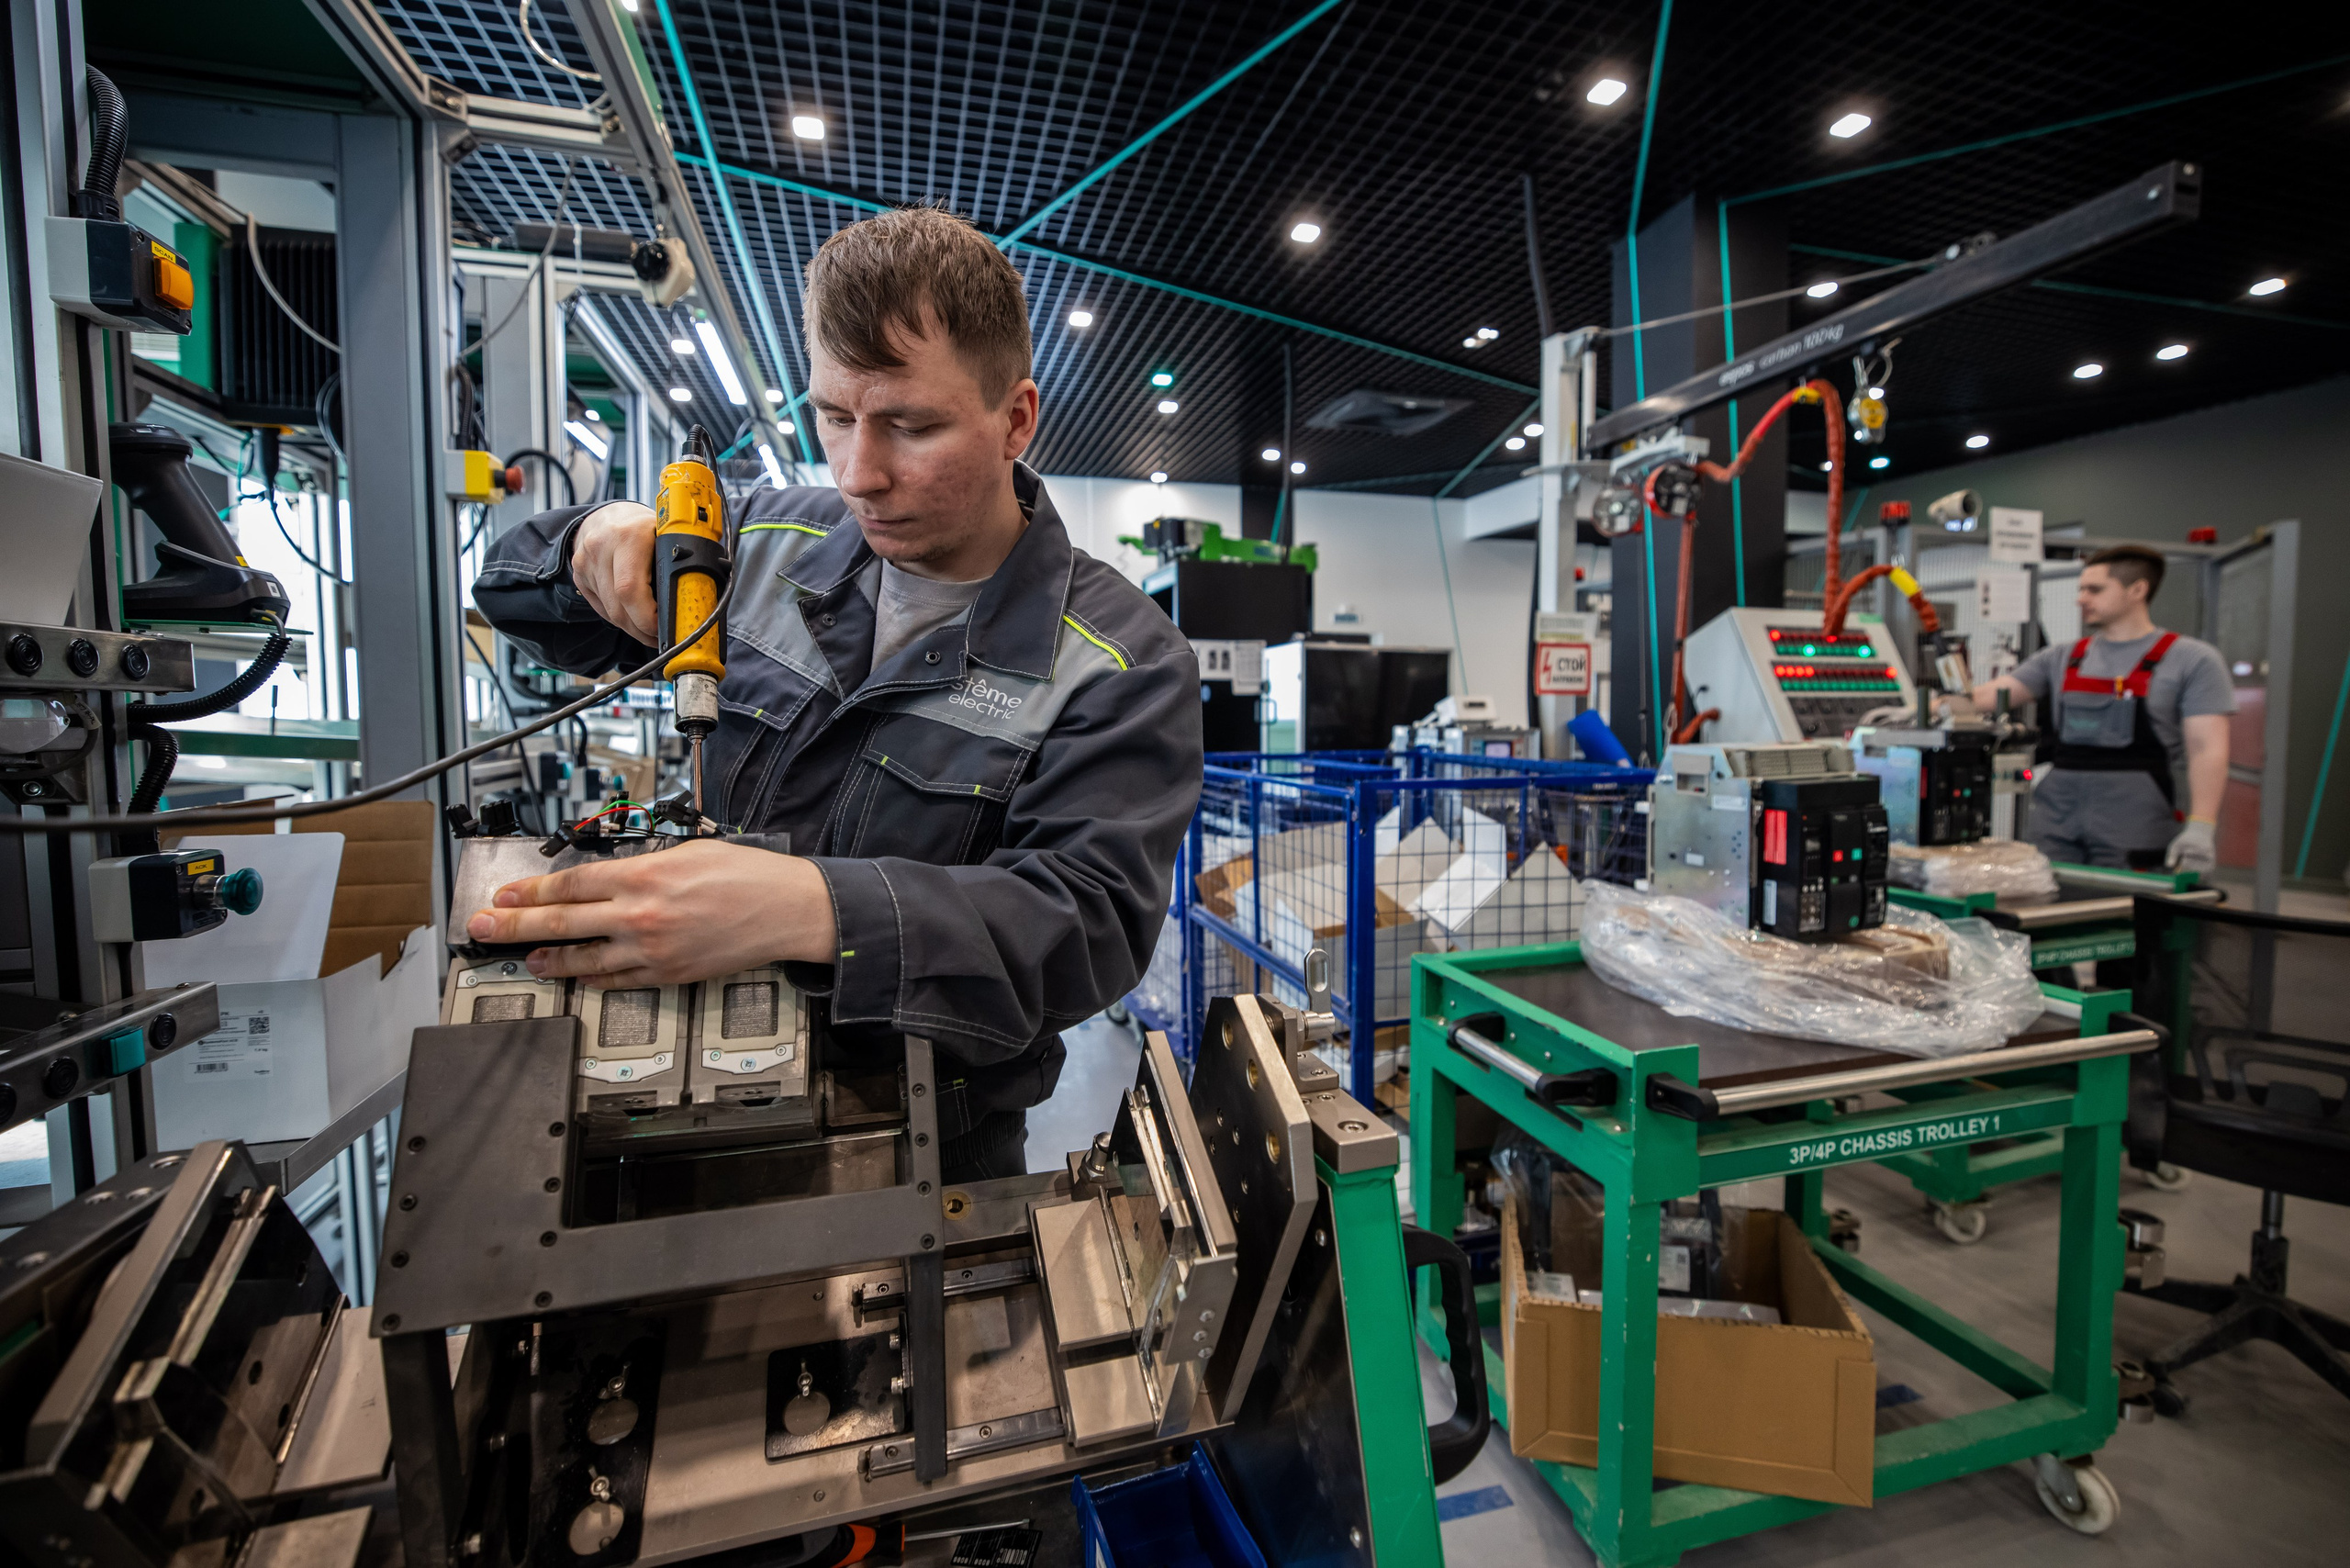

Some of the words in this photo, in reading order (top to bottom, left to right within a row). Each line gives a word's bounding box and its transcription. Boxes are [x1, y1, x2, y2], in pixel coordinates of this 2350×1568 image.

[154, 246, 173, 261] SCAN
[1558, 654, 1586, 671] СТОЙ
[948, 692, 1015, 720] electric
[1789, 1141, 1836, 1165] 3P/4P
[1840, 1128, 1912, 1157] CHASSIS
[1917, 1116, 1989, 1144] TROLLEY
[1993, 1114, 2000, 1132] 1
